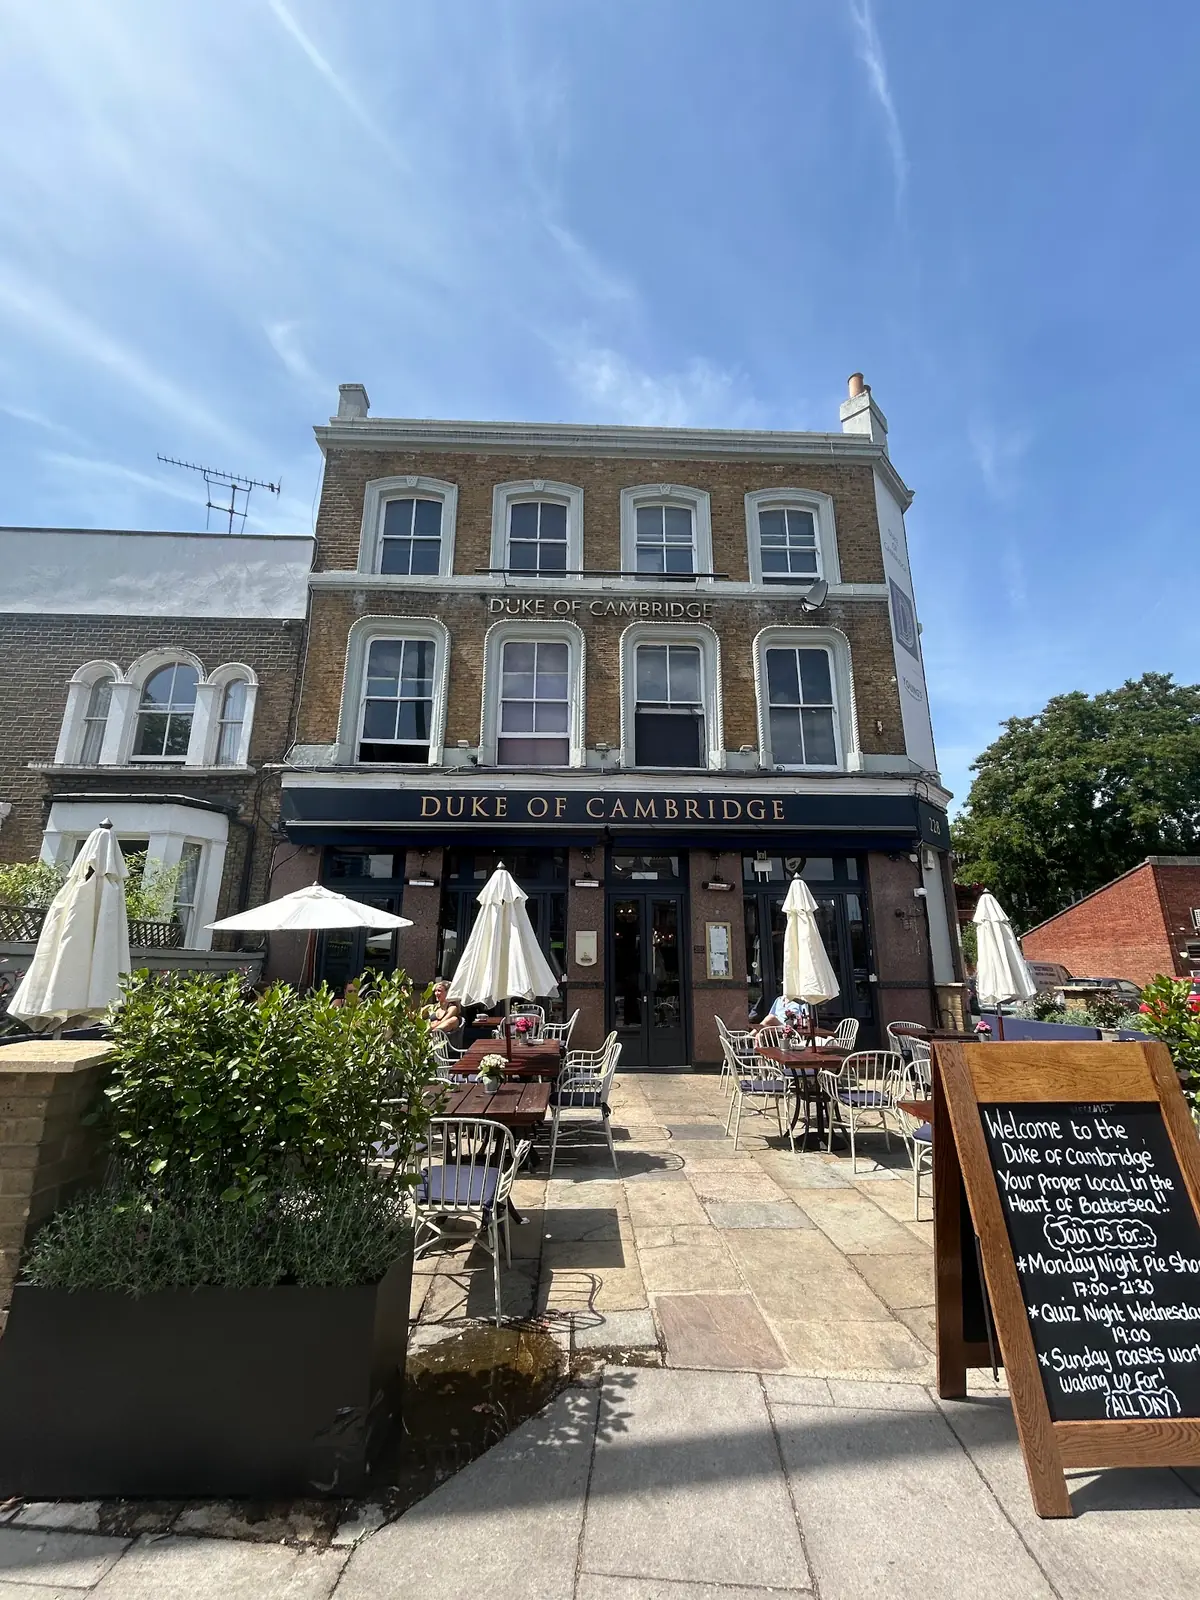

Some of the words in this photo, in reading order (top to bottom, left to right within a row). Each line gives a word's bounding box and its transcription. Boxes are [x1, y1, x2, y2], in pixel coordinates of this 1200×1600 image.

[490, 598, 545, 614] DUKE
[553, 599, 582, 615] OF
[589, 600, 714, 618] CAMBRIDGE
[420, 796, 508, 817] DUKE
[527, 797, 567, 818] OF
[586, 797, 785, 820] CAMBRIDGE
[984, 1108, 1063, 1140] Welcome
[1070, 1119, 1092, 1140] to
[1094, 1118, 1129, 1140] the
[1001, 1142, 1042, 1164] Duke
[1045, 1151, 1062, 1166] of
[1065, 1144, 1155, 1174] Cambridge
[997, 1169, 1034, 1191] Your
[1085, 1173, 1131, 1193] local
[1128, 1171, 1148, 1191] in
[1149, 1174, 1175, 1191] the
[1007, 1193, 1051, 1213] Heart
[1055, 1199, 1073, 1213] of
[1078, 1191, 1171, 1215] Battersea!!
[1050, 1220, 1091, 1245] Join
[1094, 1226, 1113, 1242] us
[1097, 1252, 1142, 1279] Night
[1082, 1298, 1126, 1328] Night
[1111, 1325, 1151, 1345] 19:00
[1116, 1346, 1165, 1367] roasts
[1113, 1373, 1132, 1391] up
[1112, 1394, 1140, 1417] ALL
[1138, 1393, 1172, 1417] DAY
